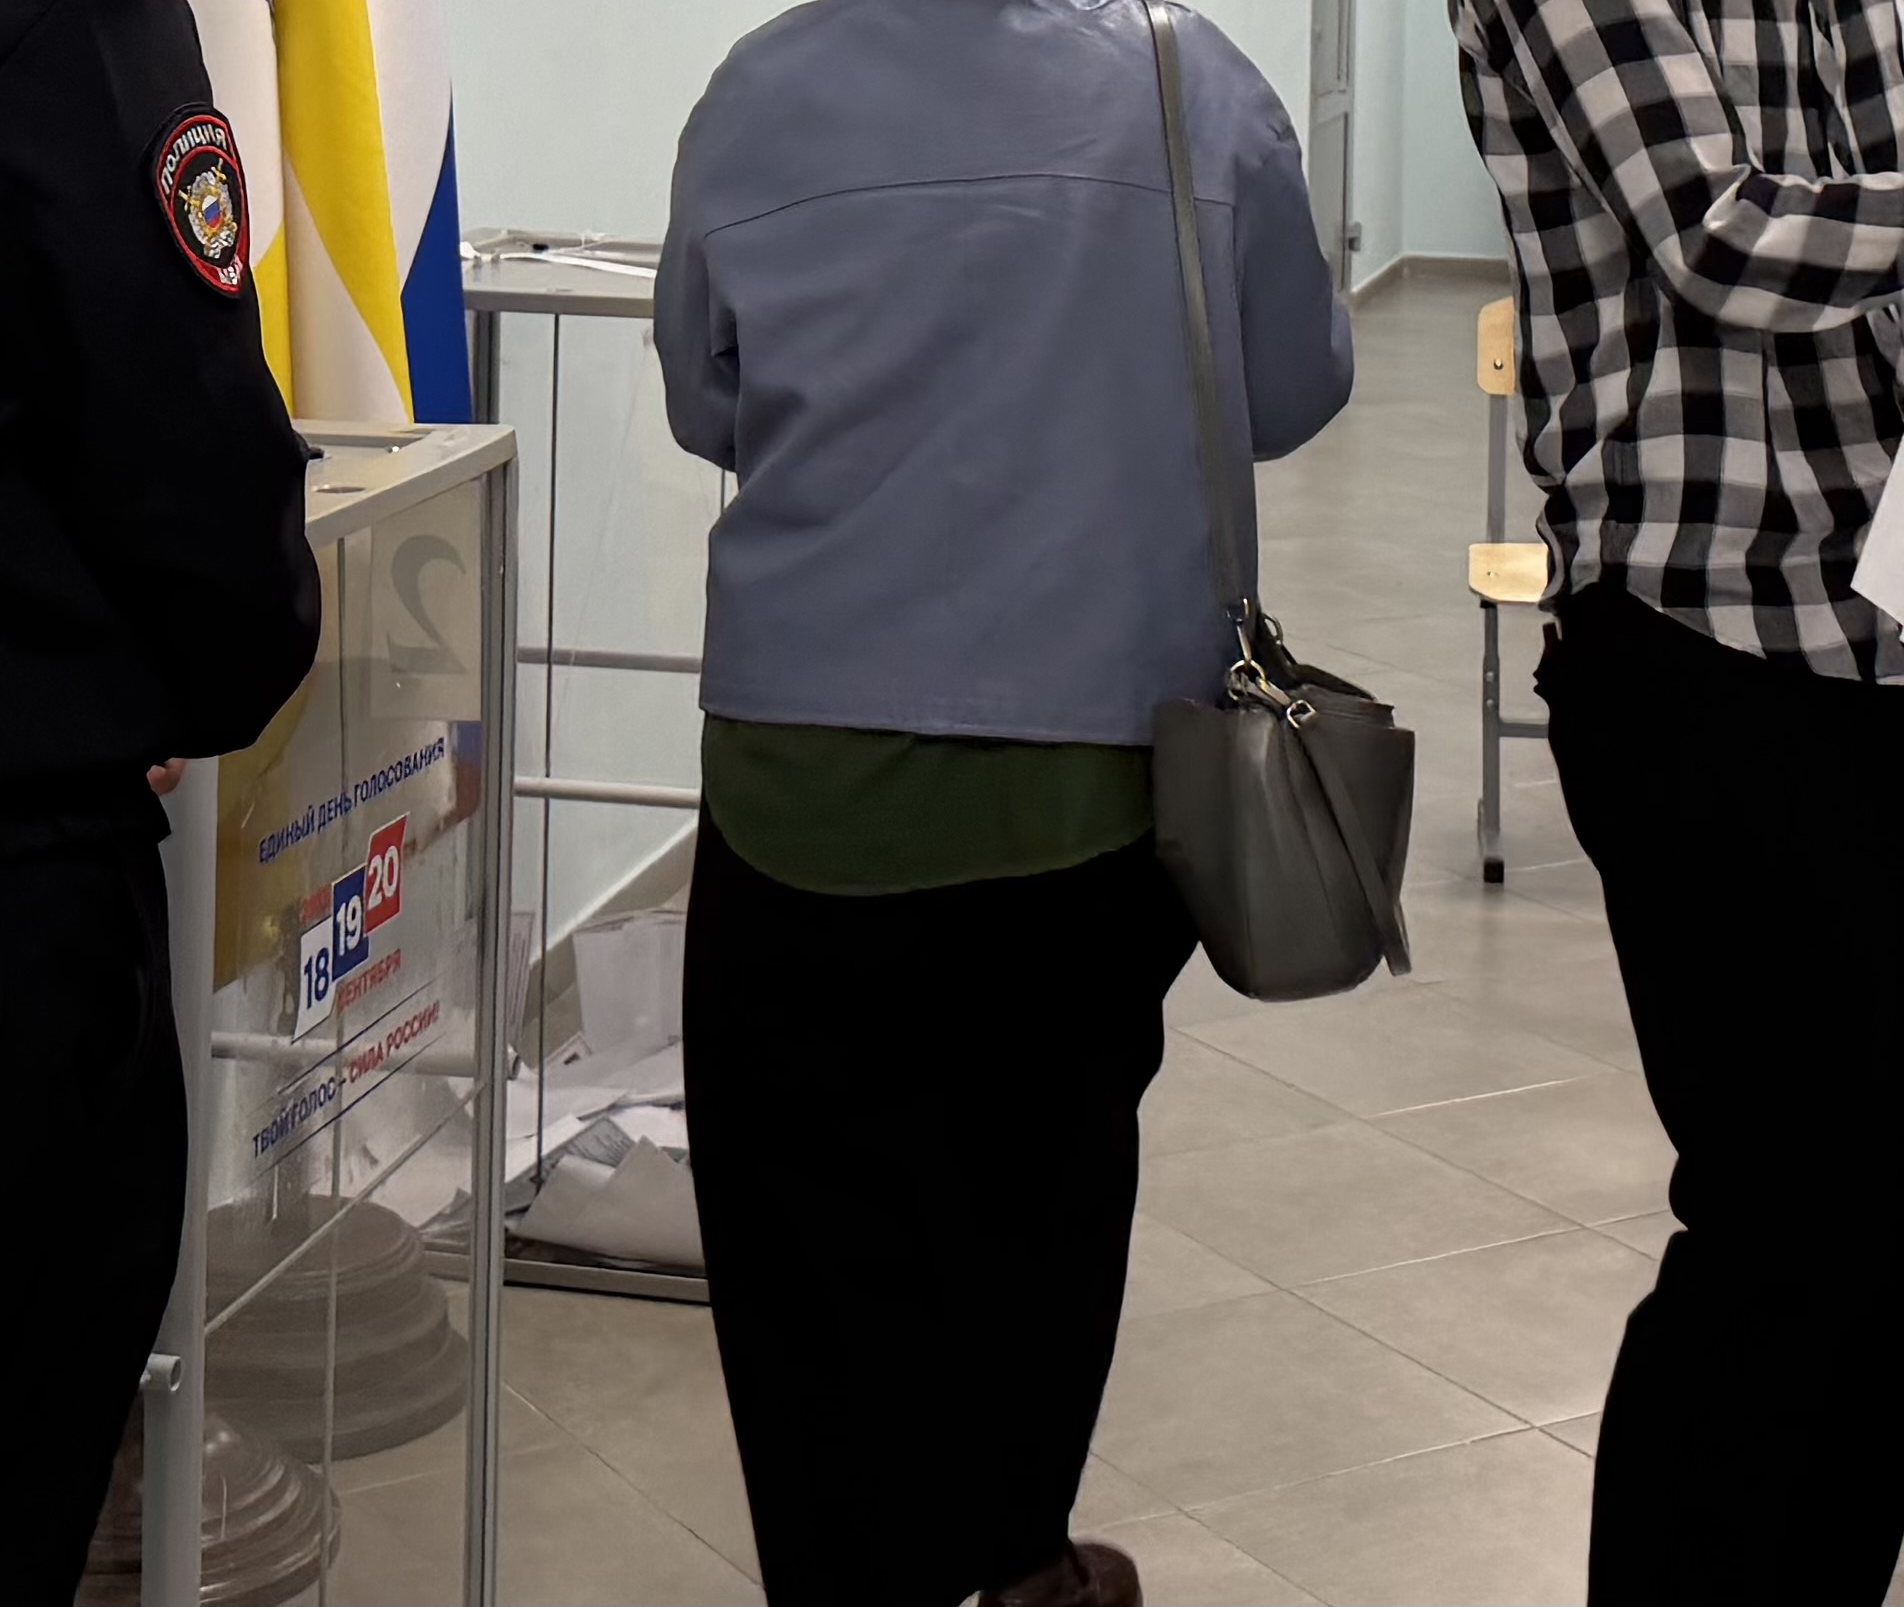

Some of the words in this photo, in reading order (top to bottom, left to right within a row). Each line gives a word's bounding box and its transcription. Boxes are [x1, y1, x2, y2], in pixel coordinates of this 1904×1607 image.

[161, 124, 228, 195] ПОЛИЦИЯ
[259, 804, 315, 864] ЕДИНЫЙ
[317, 792, 352, 833] ДЕНЬ
[353, 737, 445, 807] ГОЛОСОВАНИЯ
[304, 947, 330, 1011] 18
[336, 894, 363, 957] 19
[368, 845, 400, 910] 20
[336, 948, 401, 1014] СЕНТЯБРЯ
[253, 1105, 290, 1159] ТВОЙ
[289, 1077, 337, 1129] ГОЛОС
[349, 1042, 383, 1085] СИЛА
[386, 1000, 440, 1058] РОССИИ!
